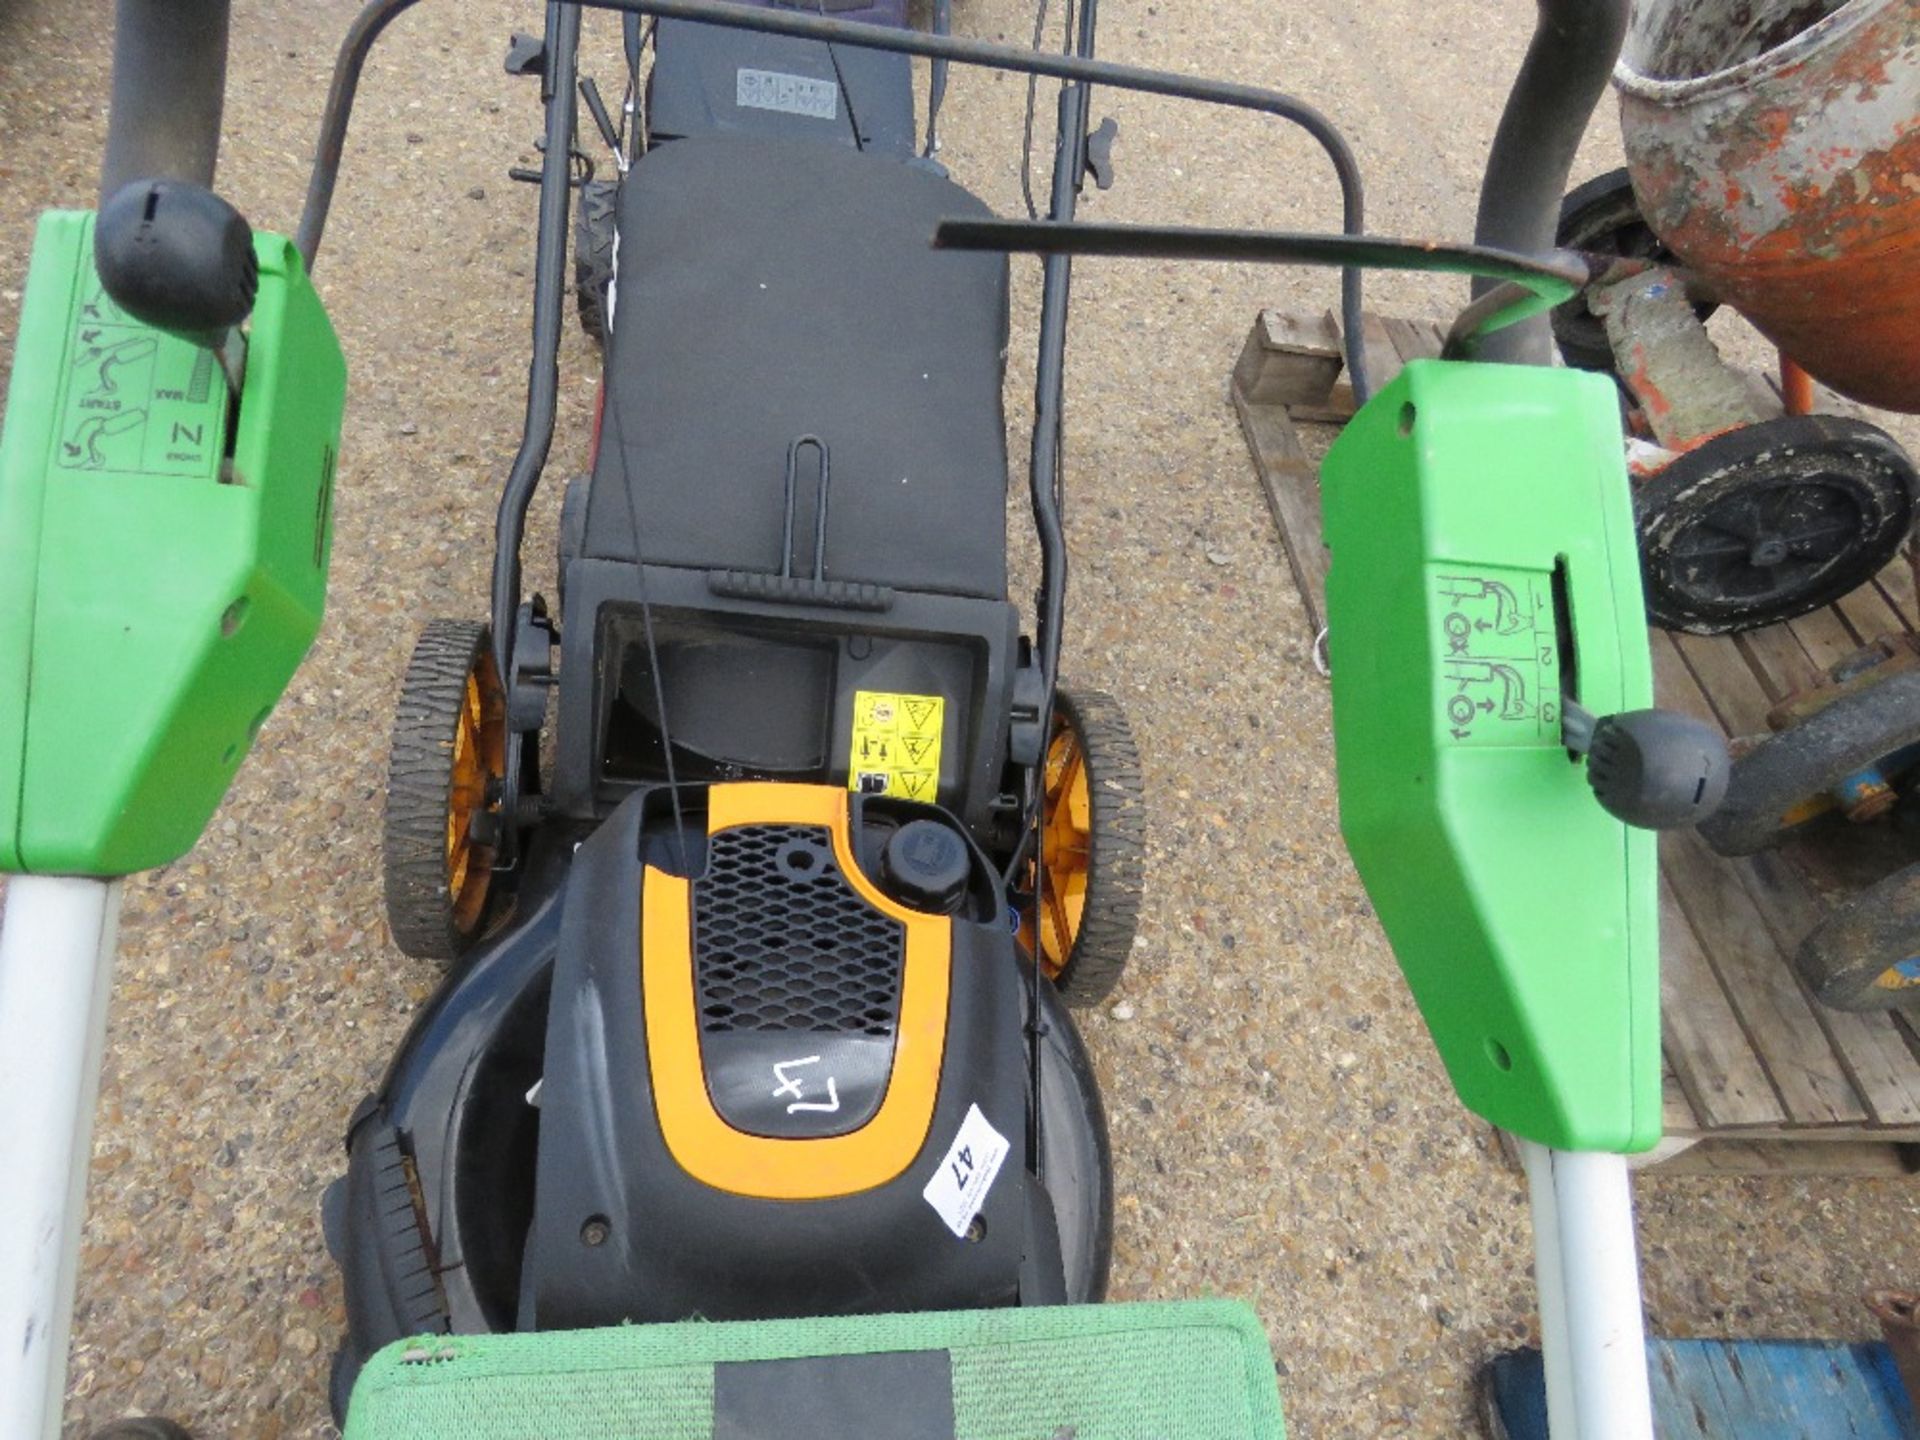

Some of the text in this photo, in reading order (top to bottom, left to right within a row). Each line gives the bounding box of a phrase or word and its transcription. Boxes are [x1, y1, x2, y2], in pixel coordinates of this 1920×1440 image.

[79, 398, 121, 411] START
[155, 388, 184, 401] MAX
[1541, 646, 1552, 666] 2
[1543, 702, 1555, 723] 3
[773, 1055, 839, 1114] 47
[951, 1144, 974, 1191] 47
